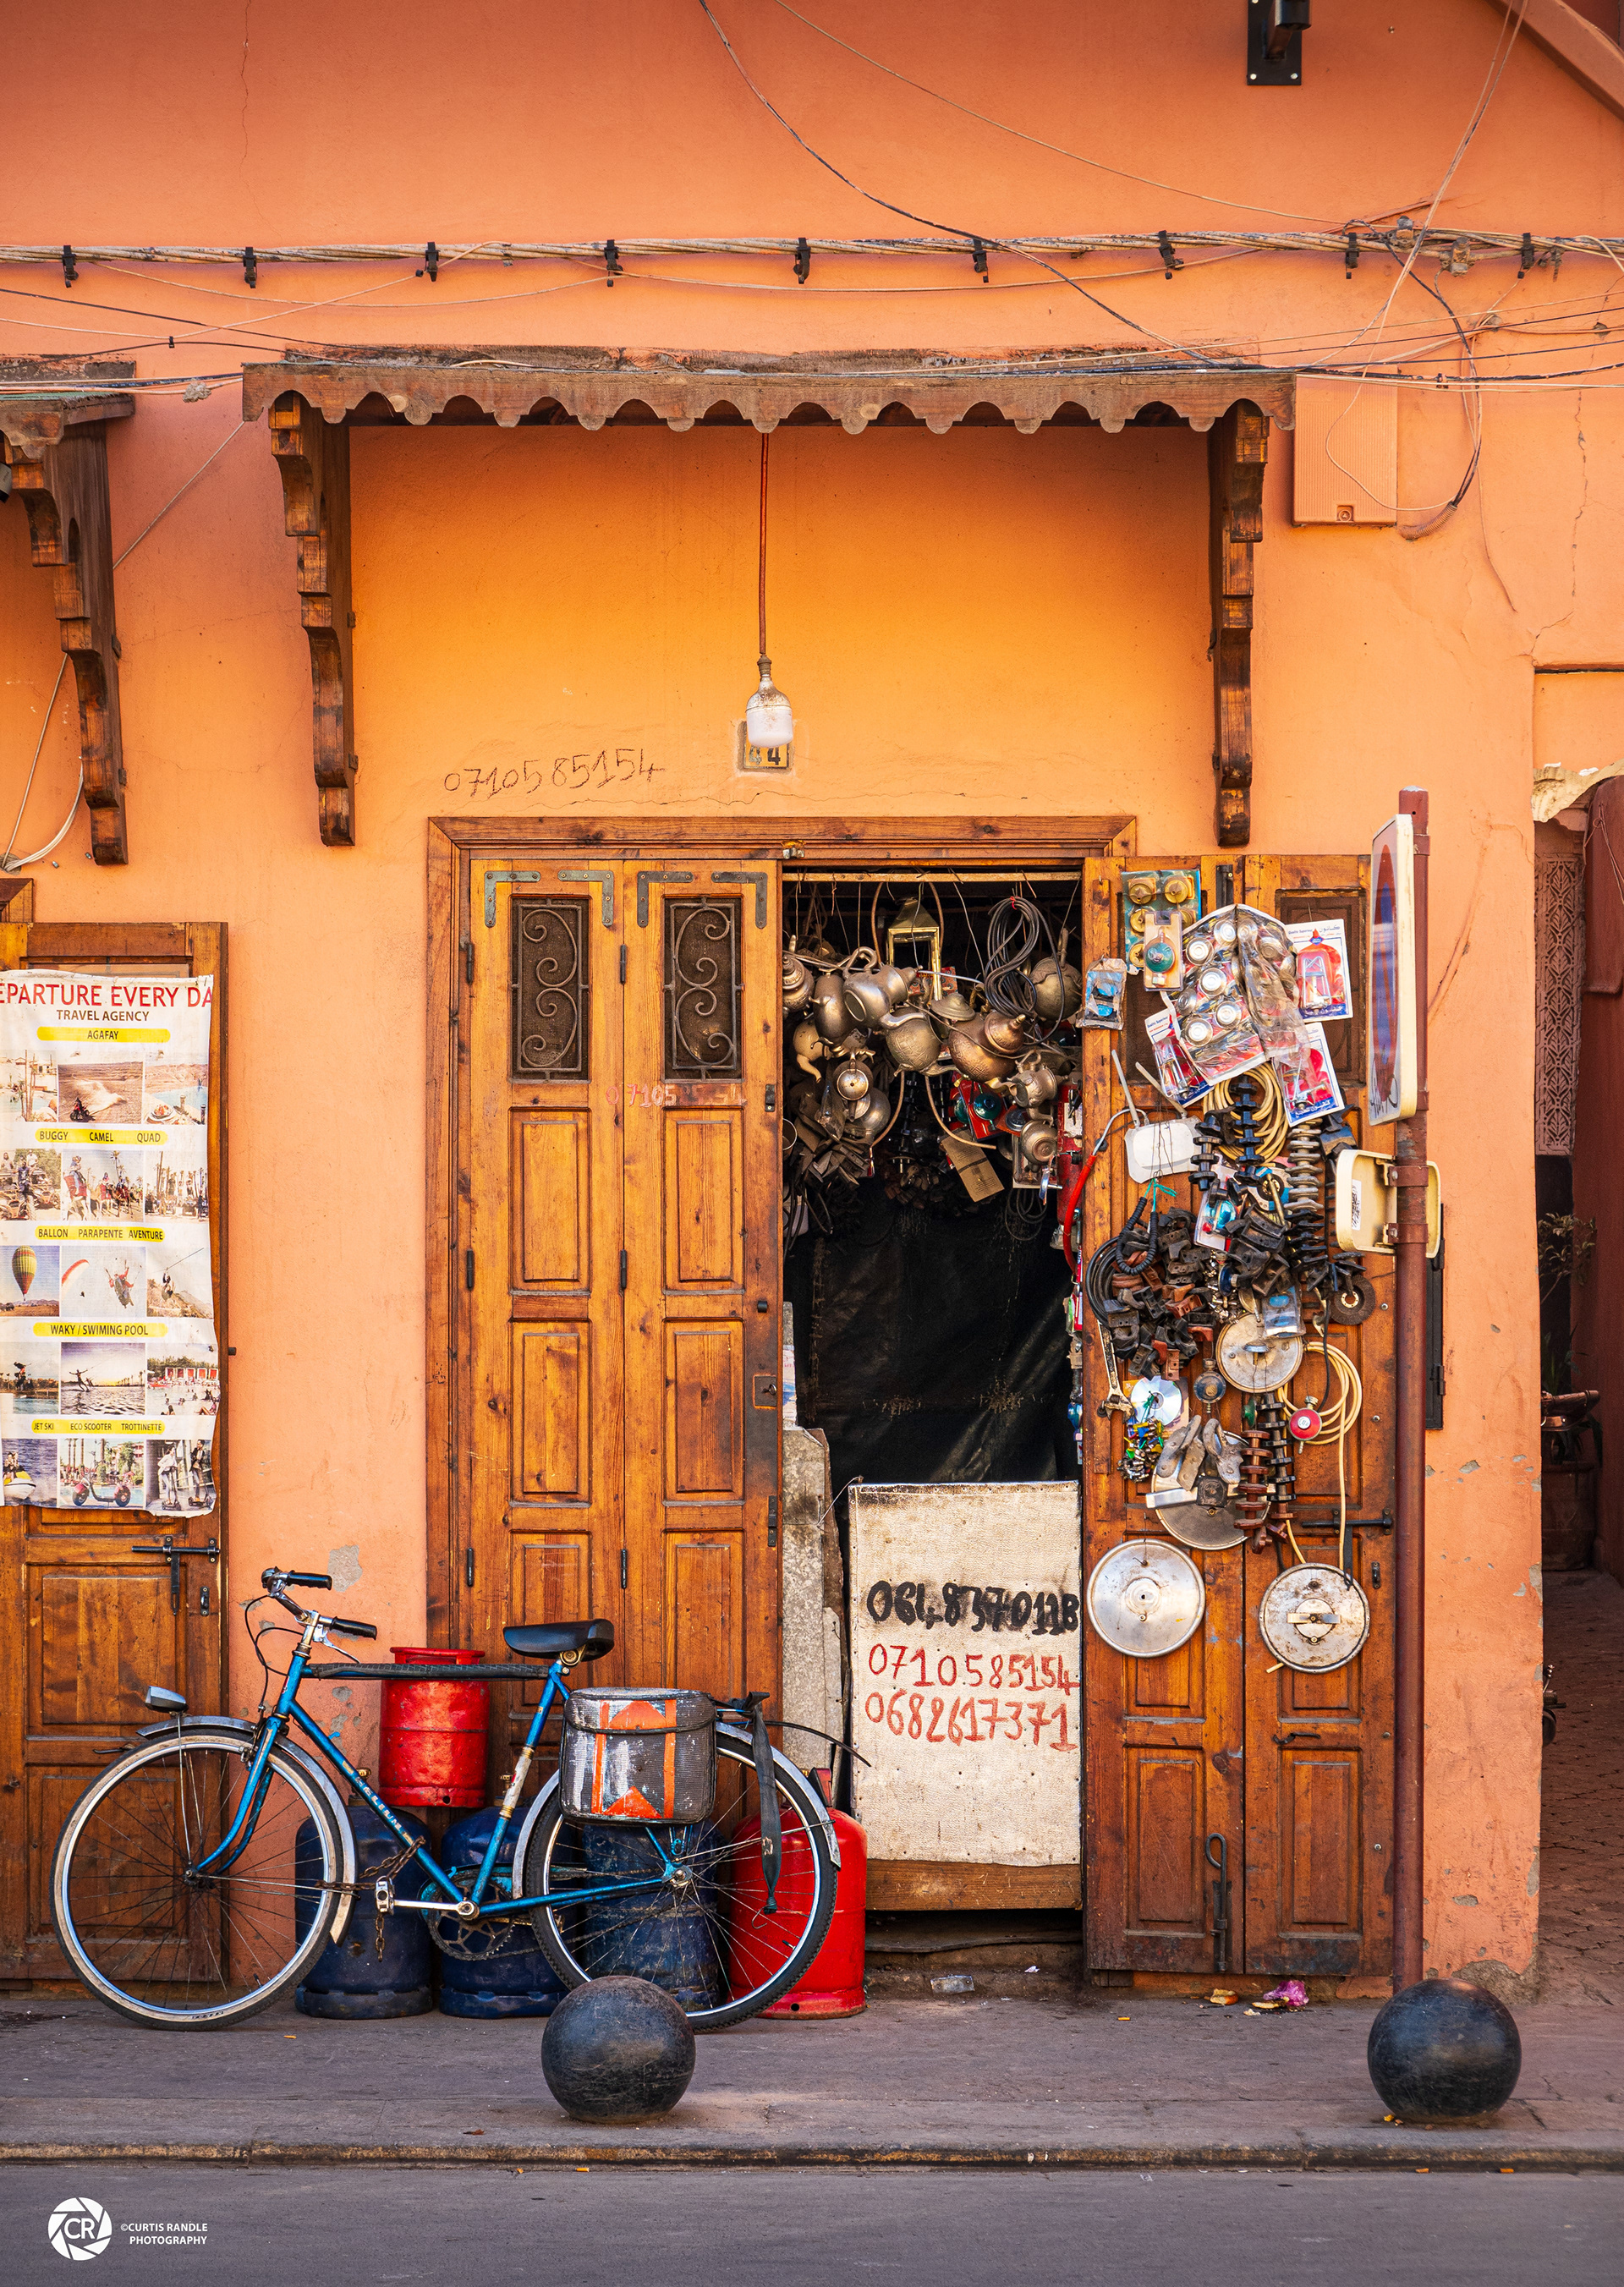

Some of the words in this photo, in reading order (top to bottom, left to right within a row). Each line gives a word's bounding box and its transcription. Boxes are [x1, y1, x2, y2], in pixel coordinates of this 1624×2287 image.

[444, 749, 667, 799] 0710585154
[111, 985, 178, 1007] EVERY
[57, 1009, 100, 1021] TRAVEL
[102, 1010, 150, 1022] AGENCY
[87, 1030, 119, 1039] AGAFAY
[40, 1131, 69, 1141] BUGGY
[89, 1132, 114, 1142] CAMEL
[137, 1133, 161, 1144] QUAD
[38, 1229, 69, 1238] BALLON
[78, 1229, 123, 1238] PARAPENTE
[129, 1230, 163, 1240] AVENTURE
[51, 1324, 76, 1335] WAKY
[83, 1324, 123, 1335] SWIMING
[124, 1325, 149, 1335] POOL
[34, 1423, 43, 1431] JET
[44, 1423, 54, 1431] SKI
[70, 1423, 83, 1431] ECO
[84, 1423, 112, 1431] SCOOTER
[121, 1423, 162, 1432] TROTTINETTE
[869, 1643, 1081, 1697] 0710585154
[865, 1688, 1078, 1752] 0682617371
